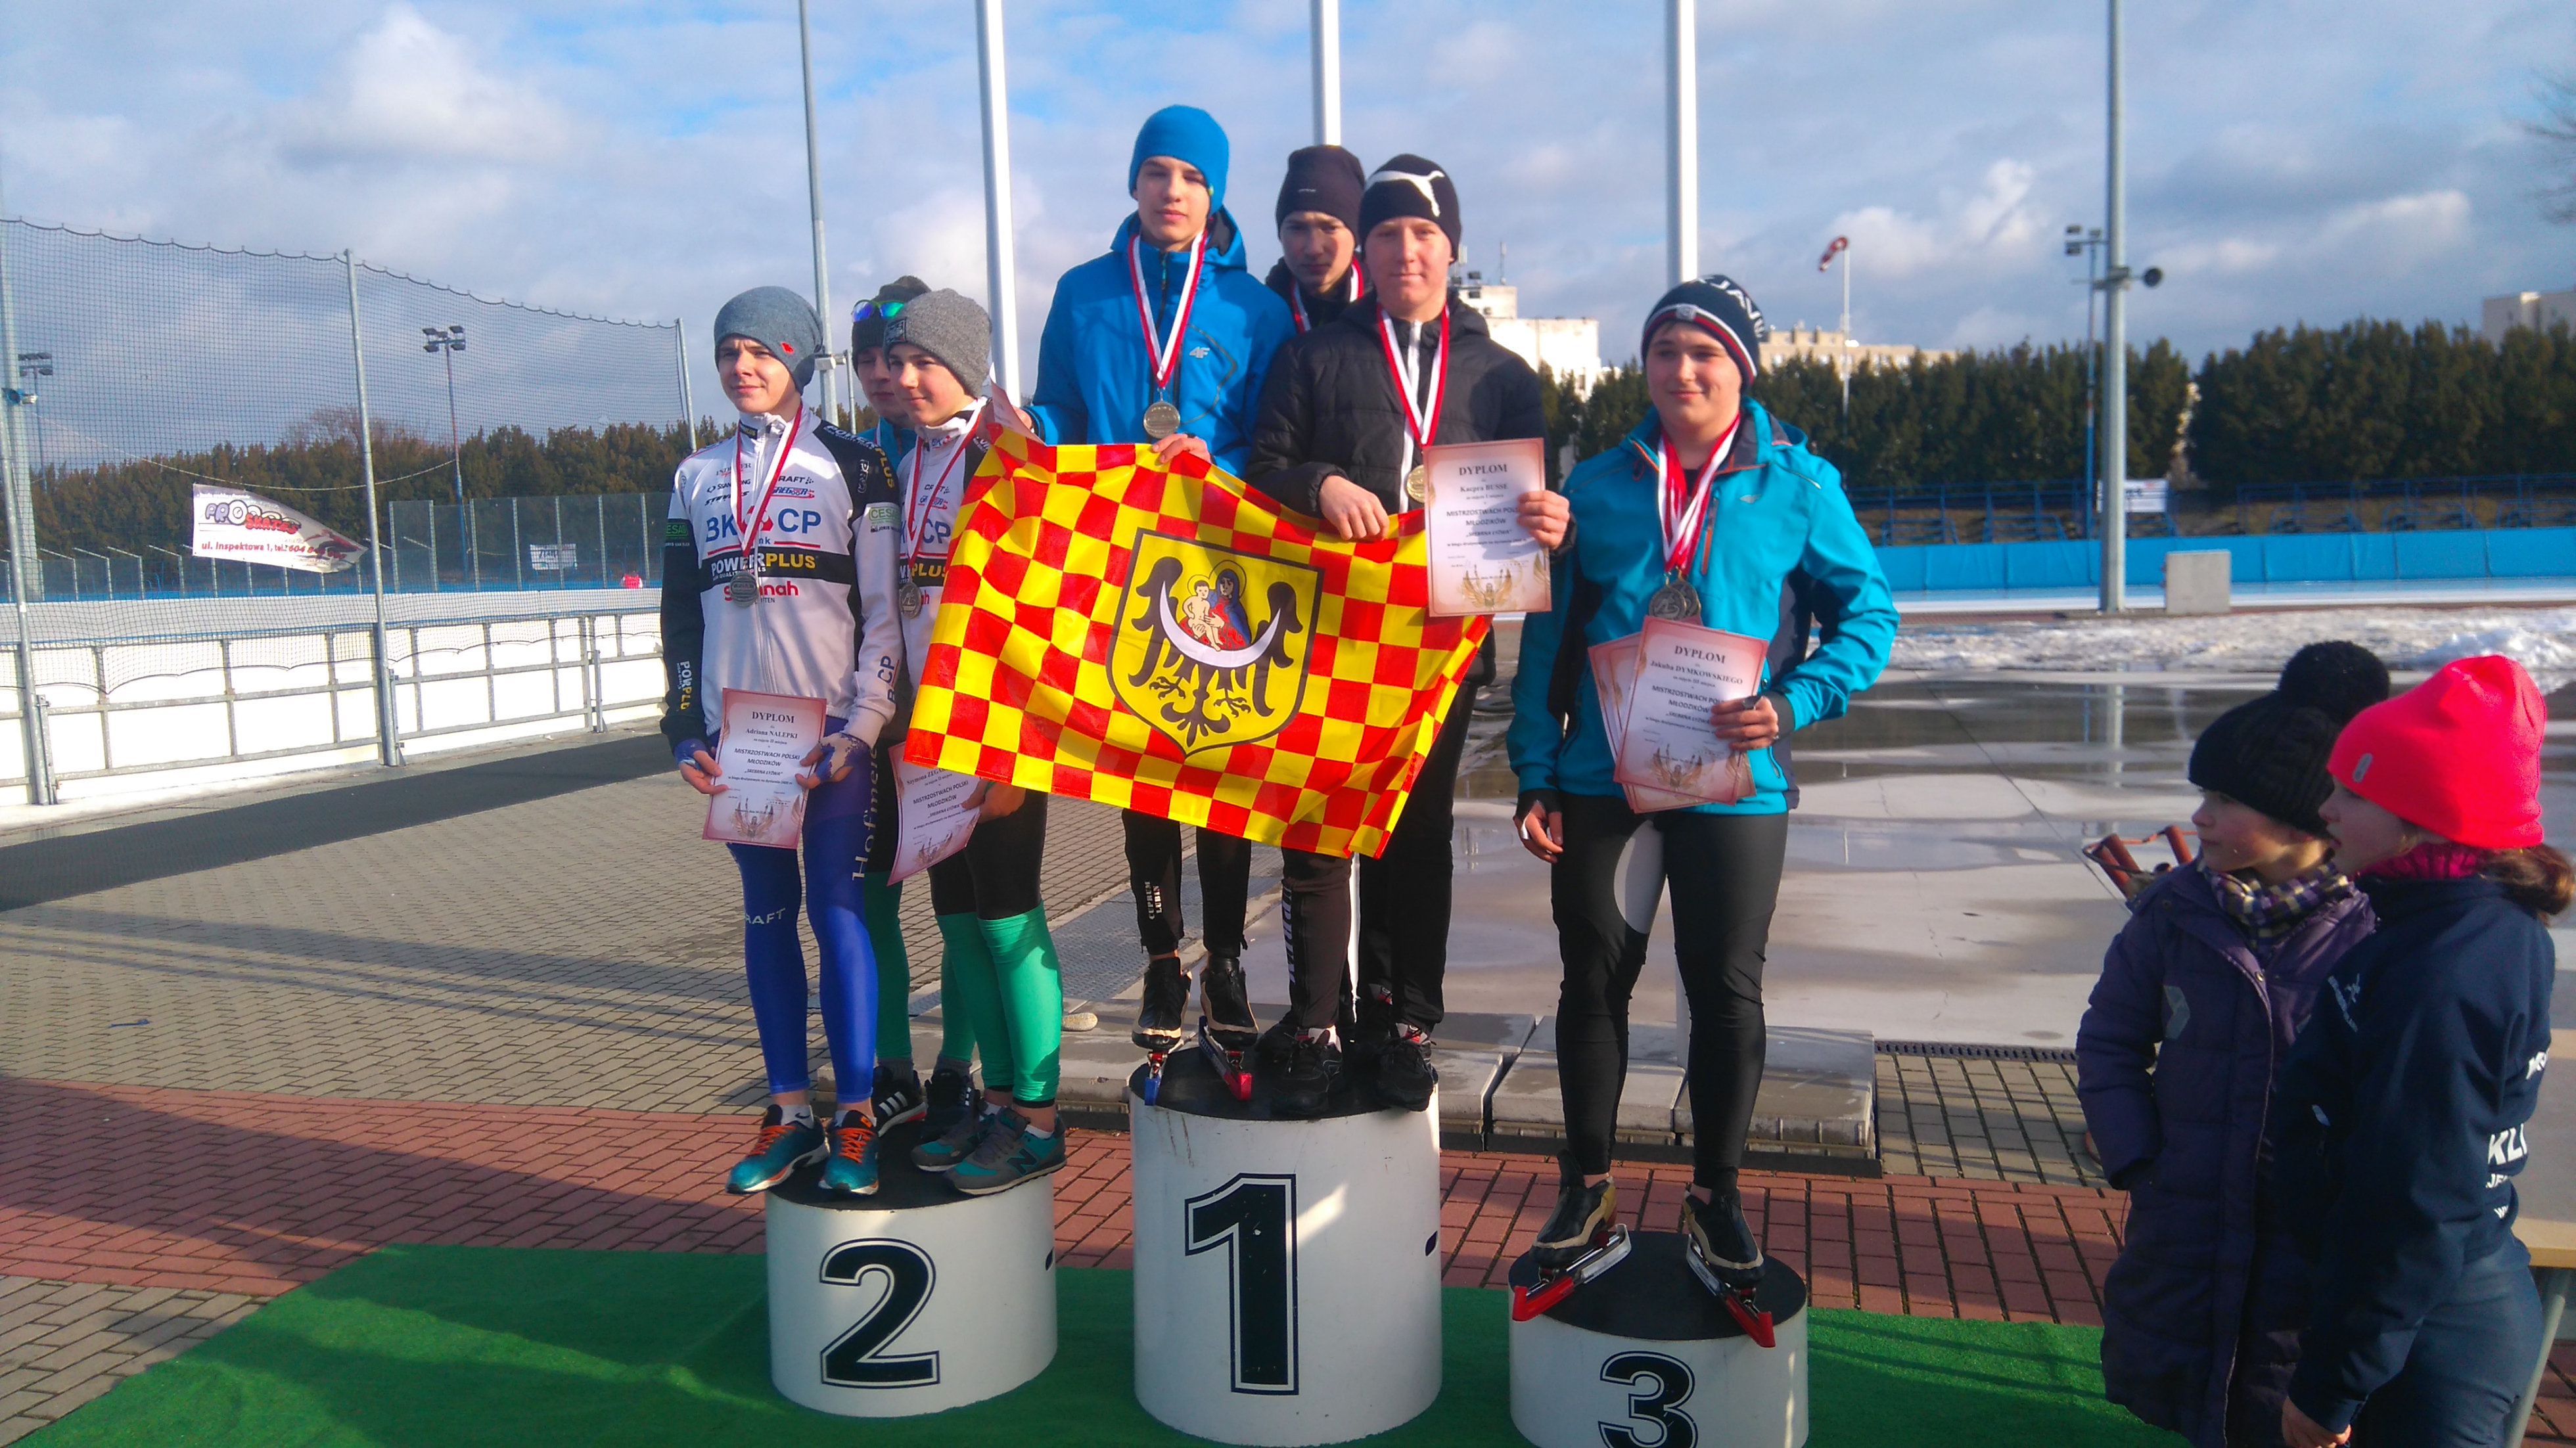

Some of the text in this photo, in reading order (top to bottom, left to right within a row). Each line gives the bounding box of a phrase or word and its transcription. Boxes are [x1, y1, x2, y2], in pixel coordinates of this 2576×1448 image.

[1189, 346, 1210, 359] 4F
[1459, 464, 1507, 476] DYPLOM
[245, 514, 302, 534] SKATES
[778, 509, 821, 533] CP
[1465, 518, 1506, 526] MŁODZIKÓW
[923, 518, 951, 544] CP
[712, 553, 816, 577] POWERPLUS
[1674, 645, 1726, 664] DYPLOM
[877, 656, 894, 684] CP
[1650, 660, 1743, 685] Jakuba DYMKOWSKIEGO
[1651, 685, 1707, 702] MISTRZOSTWACH
[1668, 699, 1709, 713] MŁODZIKÓW
[752, 712, 794, 723] DYPLOM
[769, 730, 798, 739] NALEPKI
[734, 748, 781, 758] MISTRZOSTWACH
[747, 758, 782, 767] MŁODZIKÓW
[906, 774, 927, 785] Szymona
[913, 780, 969, 804] MISTRZOSTWACH POLSKI
[927, 794, 957, 809] MŁODZIKÓW
[1144, 881, 1155, 920] CUPRUM
[1153, 885, 1162, 914] LUBIN
[745, 907, 786, 925] RAFT
[1185, 1173, 1299, 1395] 1
[819, 1237, 940, 1390] 2
[1598, 1351, 1699, 1448] 3
